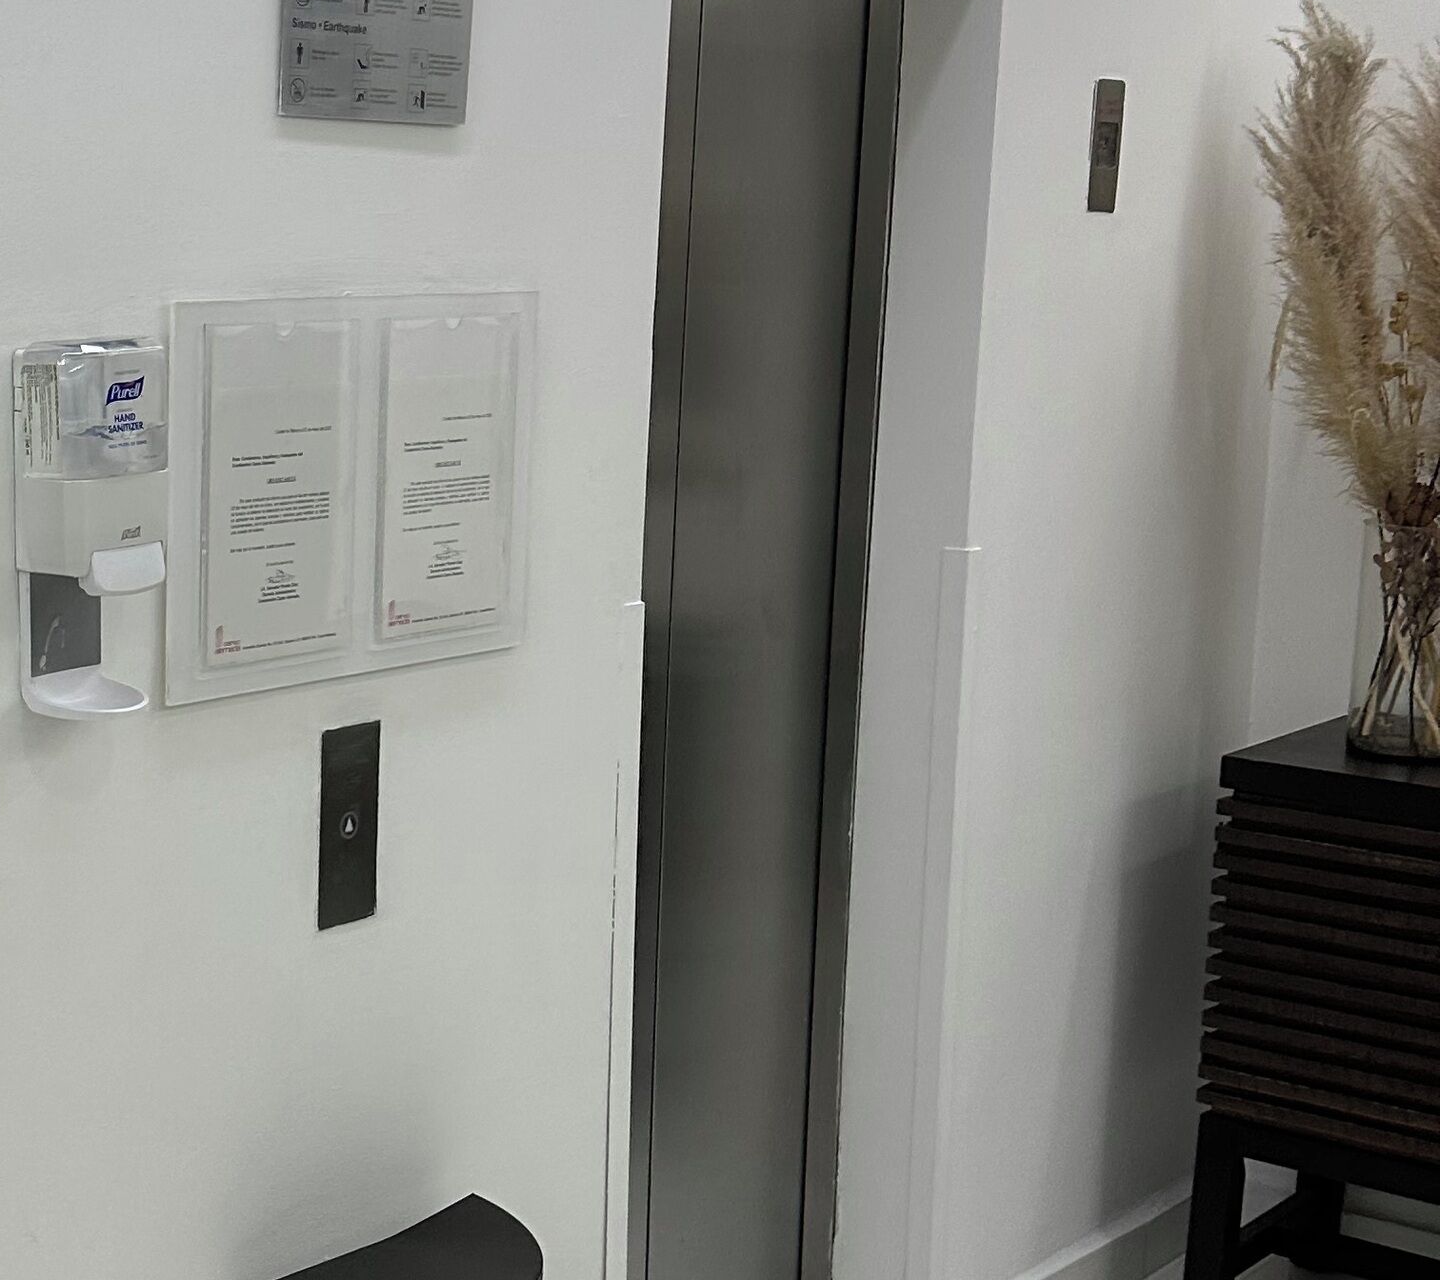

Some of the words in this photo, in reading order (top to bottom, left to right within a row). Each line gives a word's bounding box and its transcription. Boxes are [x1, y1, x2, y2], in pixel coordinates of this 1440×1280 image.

[323, 20, 367, 35] Earthquake
[113, 412, 136, 423] HAND
[107, 421, 145, 434] SANITIZER
